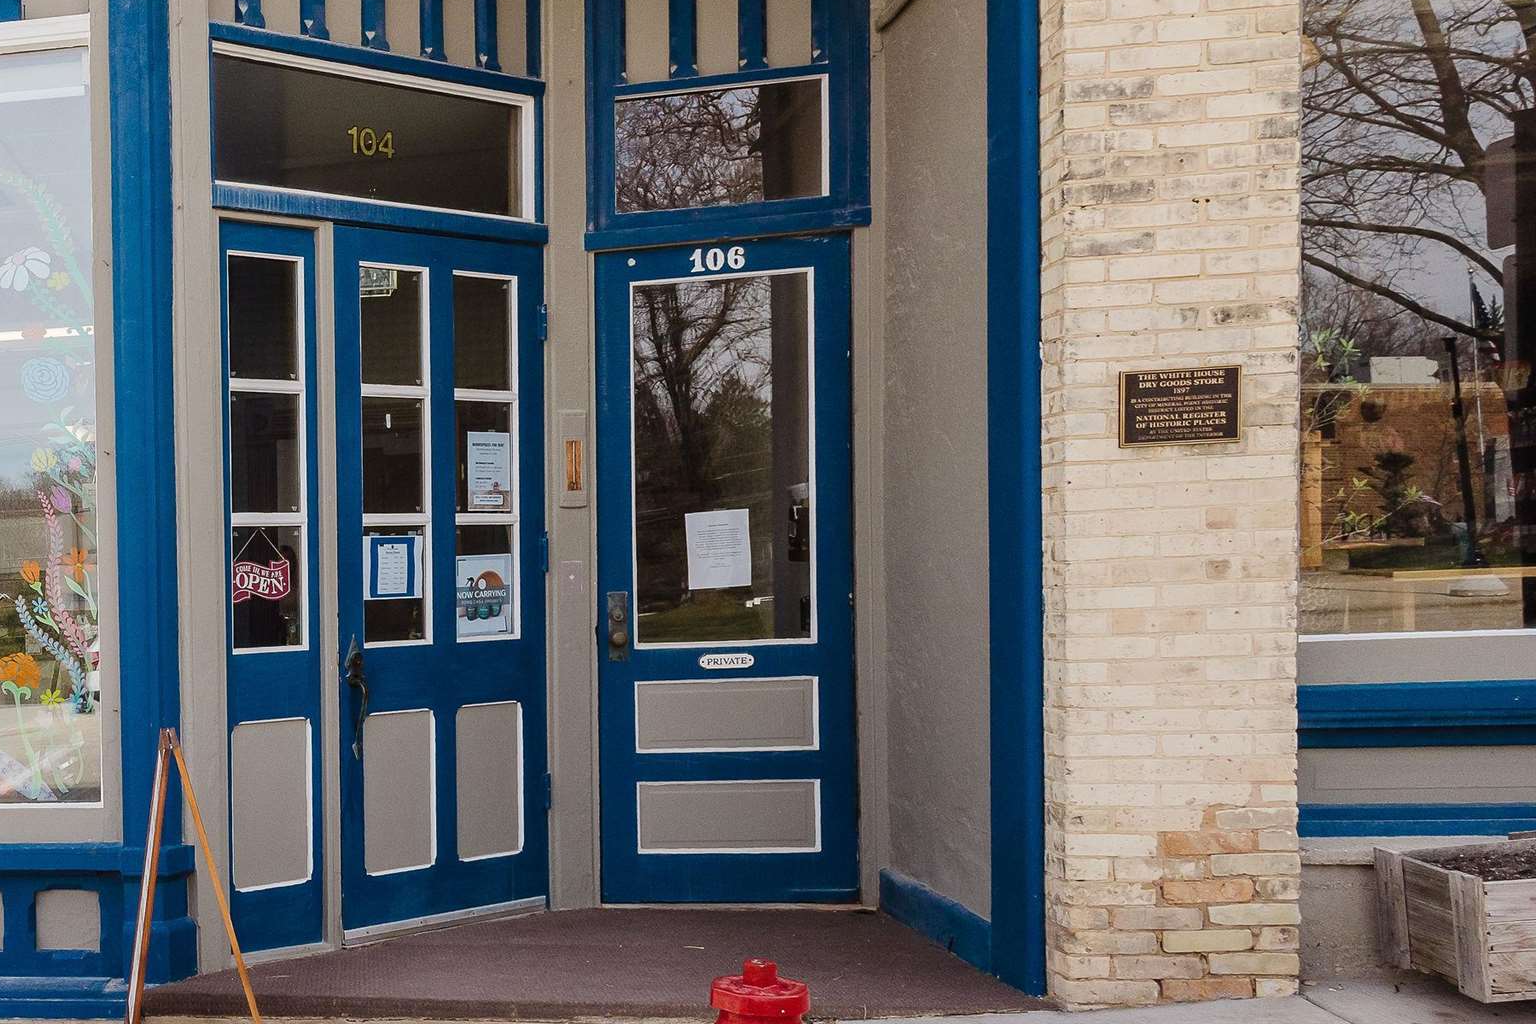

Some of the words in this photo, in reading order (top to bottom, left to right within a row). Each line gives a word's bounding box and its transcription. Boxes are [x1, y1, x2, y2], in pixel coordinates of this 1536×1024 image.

[347, 126, 394, 159] 104
[689, 246, 746, 273] 106
[1160, 379, 1192, 387] GOODS
[1150, 420, 1191, 428] HISTORIC
[235, 572, 284, 594] OPEN
[456, 591, 474, 599] NOW
[474, 589, 506, 598] CARRYING
[706, 656, 748, 666] PRIVATE
